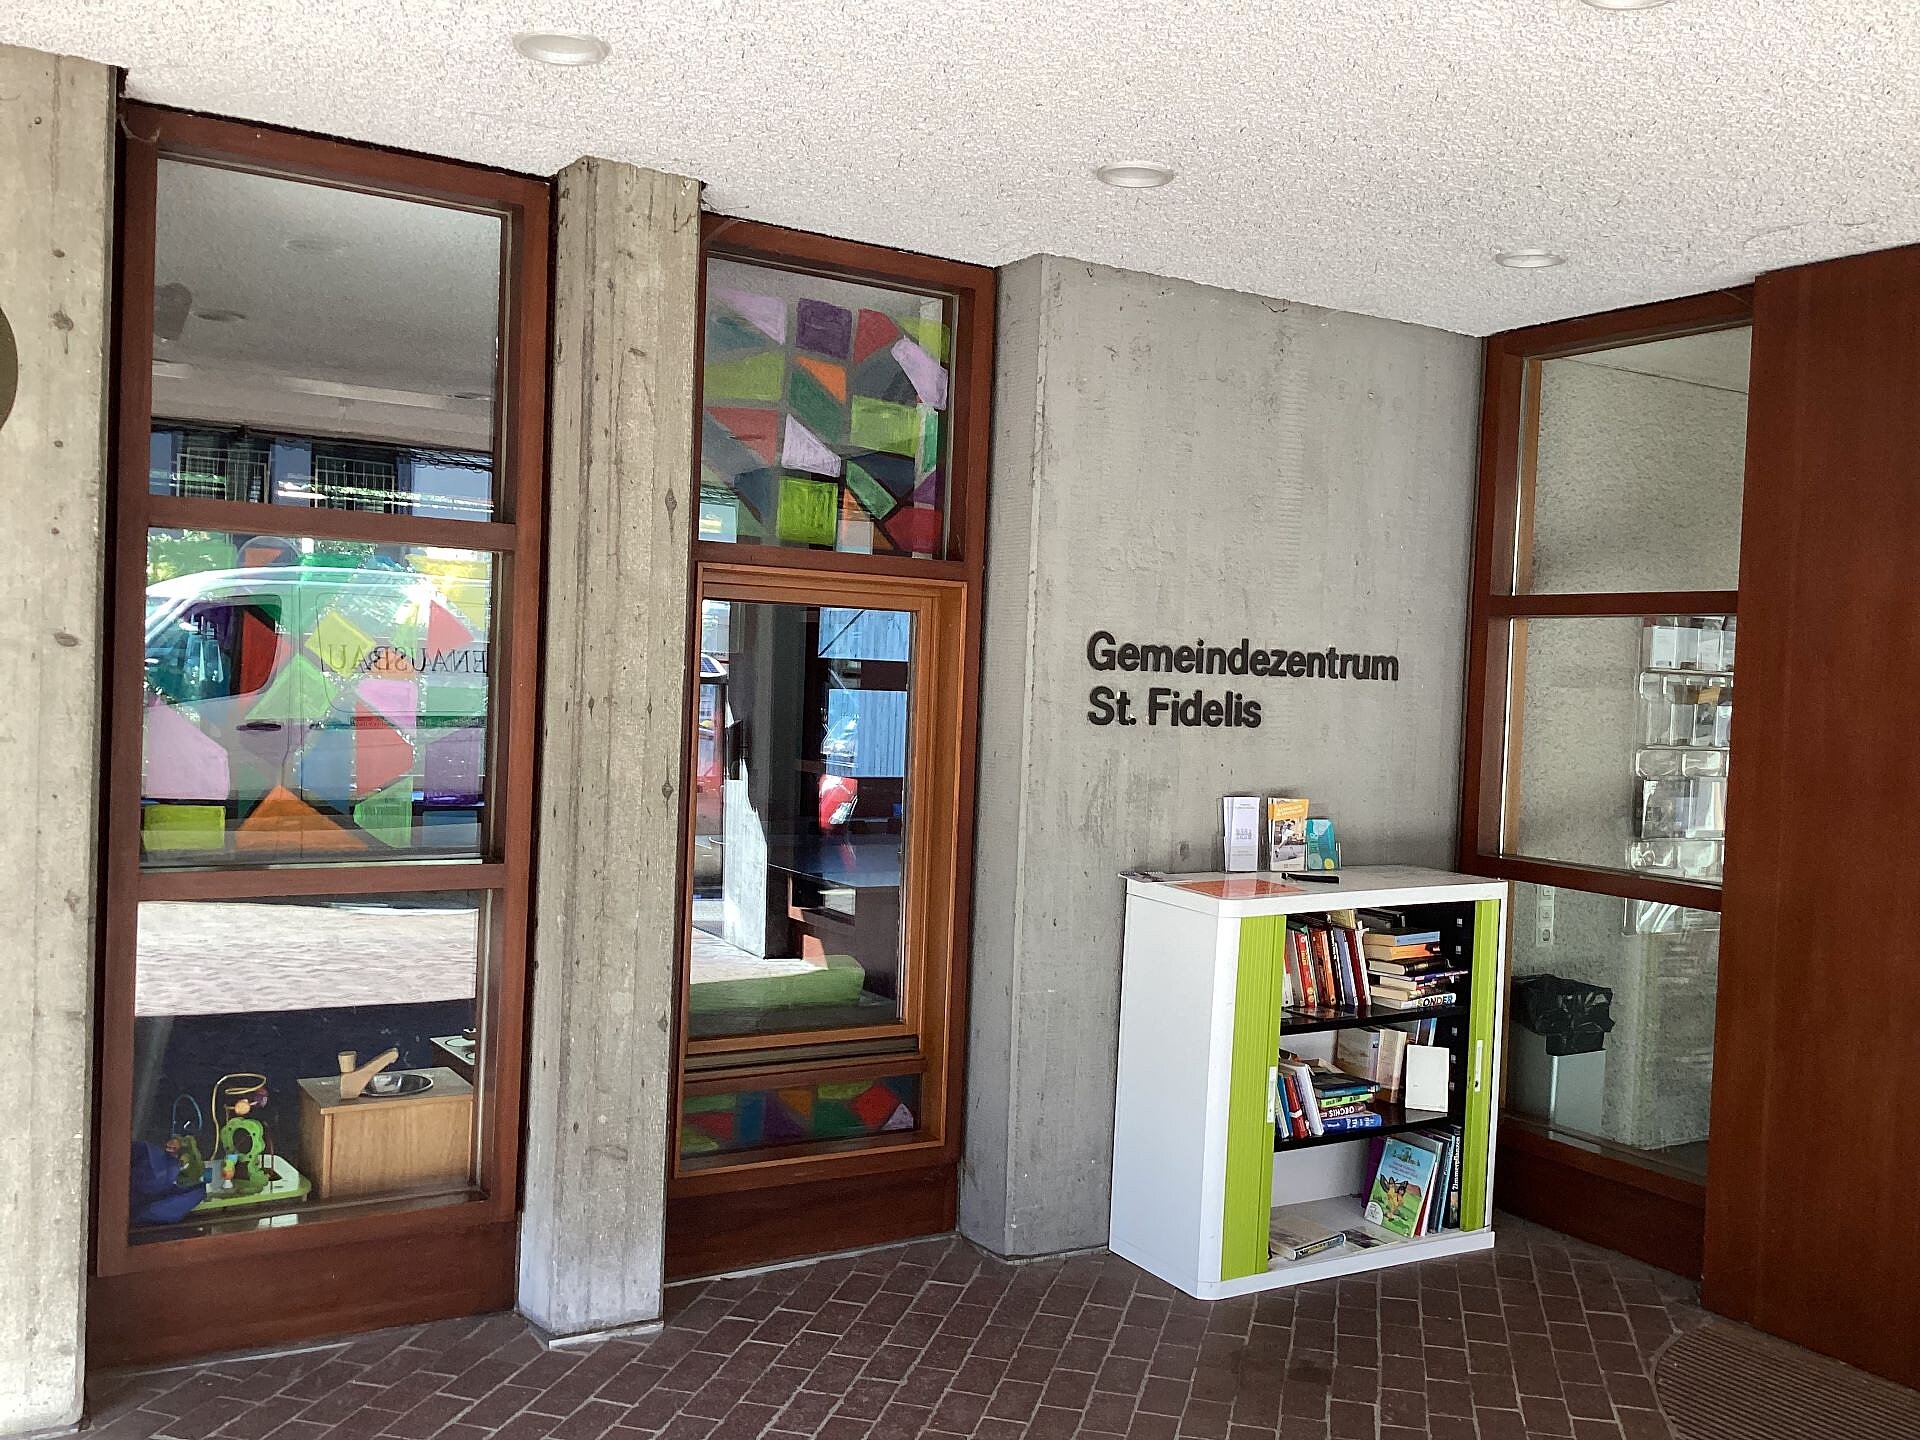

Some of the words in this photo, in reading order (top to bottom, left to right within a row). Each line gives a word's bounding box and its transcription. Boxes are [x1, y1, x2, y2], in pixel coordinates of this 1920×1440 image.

[1087, 630, 1399, 681] Gemeindezentrum
[1087, 686, 1137, 726] St.
[1148, 688, 1262, 728] Fidelis
